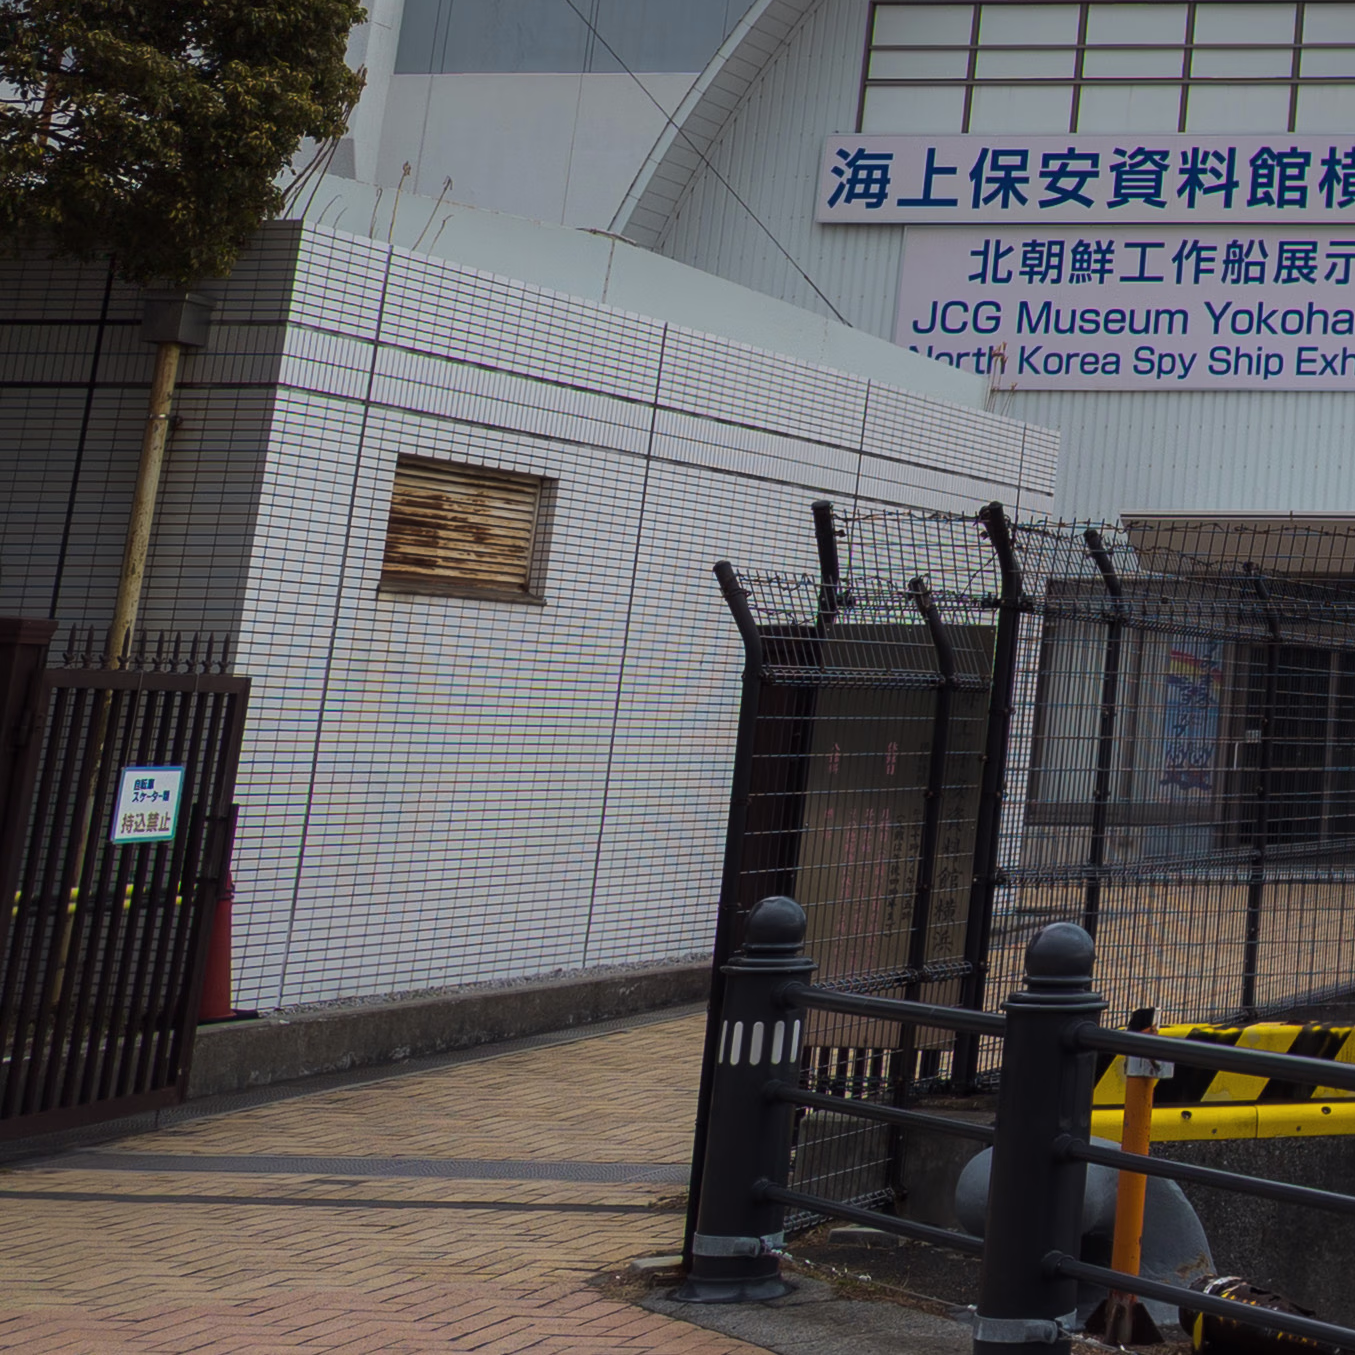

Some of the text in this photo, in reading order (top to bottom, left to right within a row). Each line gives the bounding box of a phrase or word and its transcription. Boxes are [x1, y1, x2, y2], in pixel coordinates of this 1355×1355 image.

[912, 300, 1002, 334] JCG
[1016, 300, 1189, 335] Museum
[1018, 346, 1121, 375] Korea
[1133, 346, 1197, 379] Spy
[1208, 346, 1284, 380] Ship
[120, 811, 171, 834] 持込禁止
